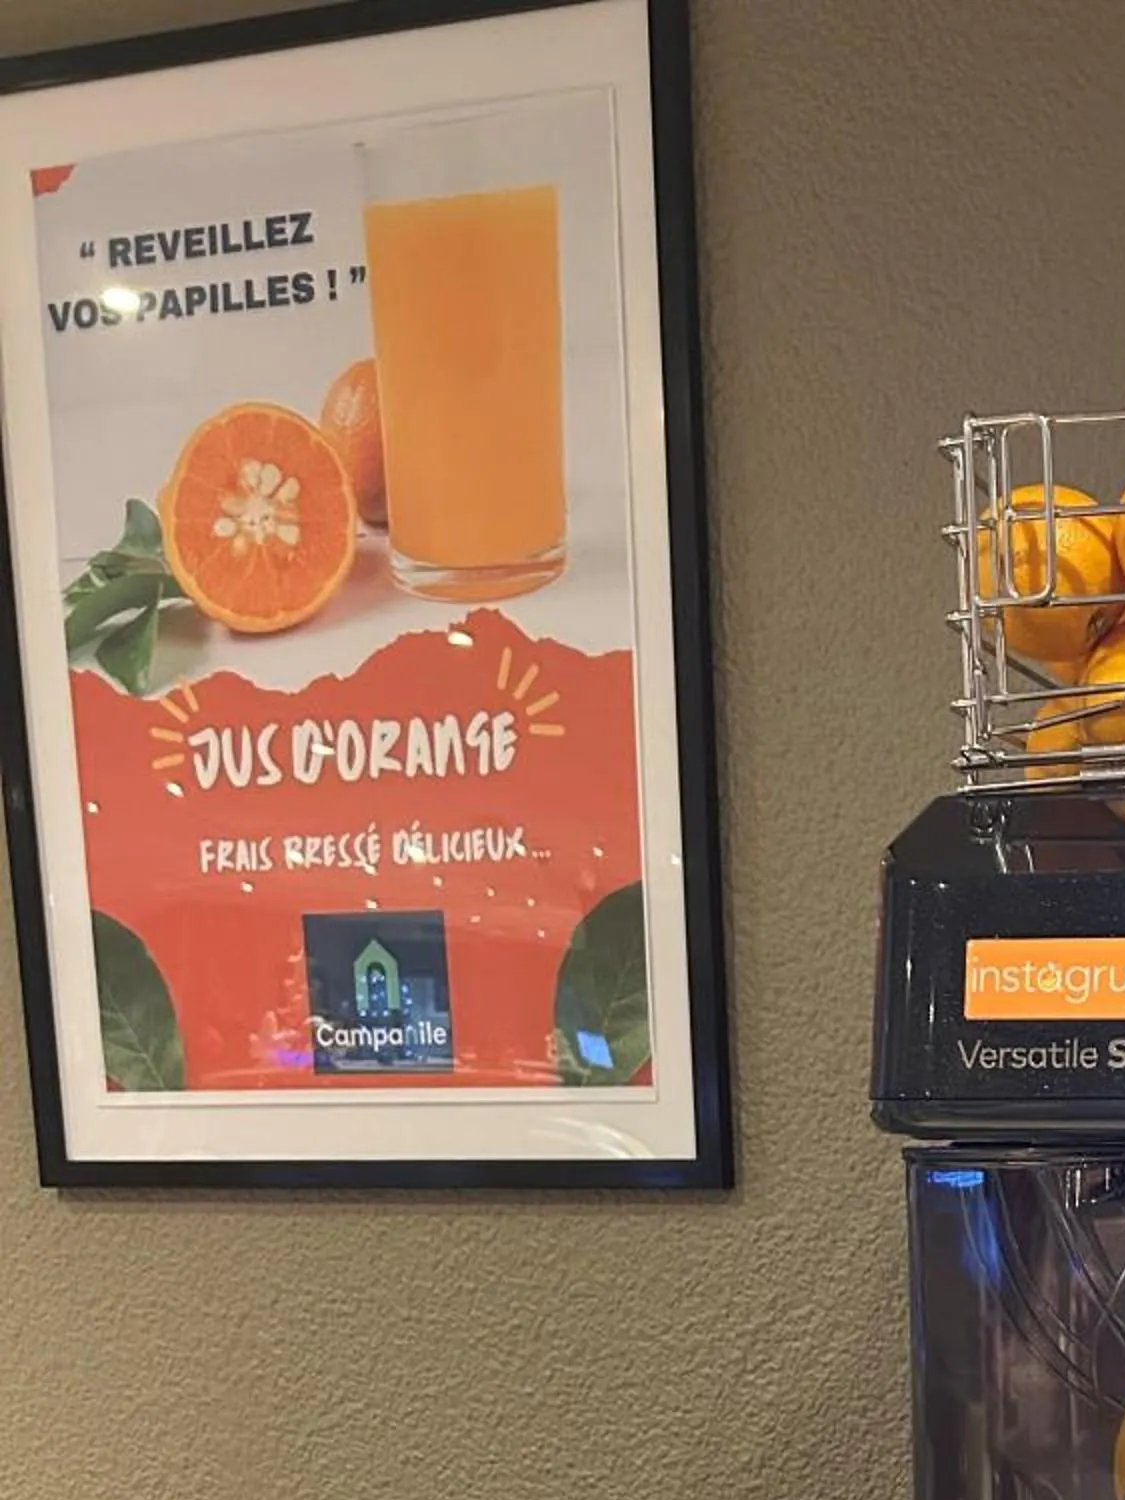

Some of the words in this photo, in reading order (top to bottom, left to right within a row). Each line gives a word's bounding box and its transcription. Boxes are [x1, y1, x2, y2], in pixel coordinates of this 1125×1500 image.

[108, 211, 314, 268] REVEILLEZ
[47, 297, 122, 333] VOS
[134, 271, 316, 323] PAPILLES
[188, 723, 283, 790] JUS
[291, 711, 519, 785] D'ORANGE
[199, 837, 273, 873] FRAIS
[315, 1021, 448, 1050] Campanile
[957, 1038, 1099, 1070] Versatile
